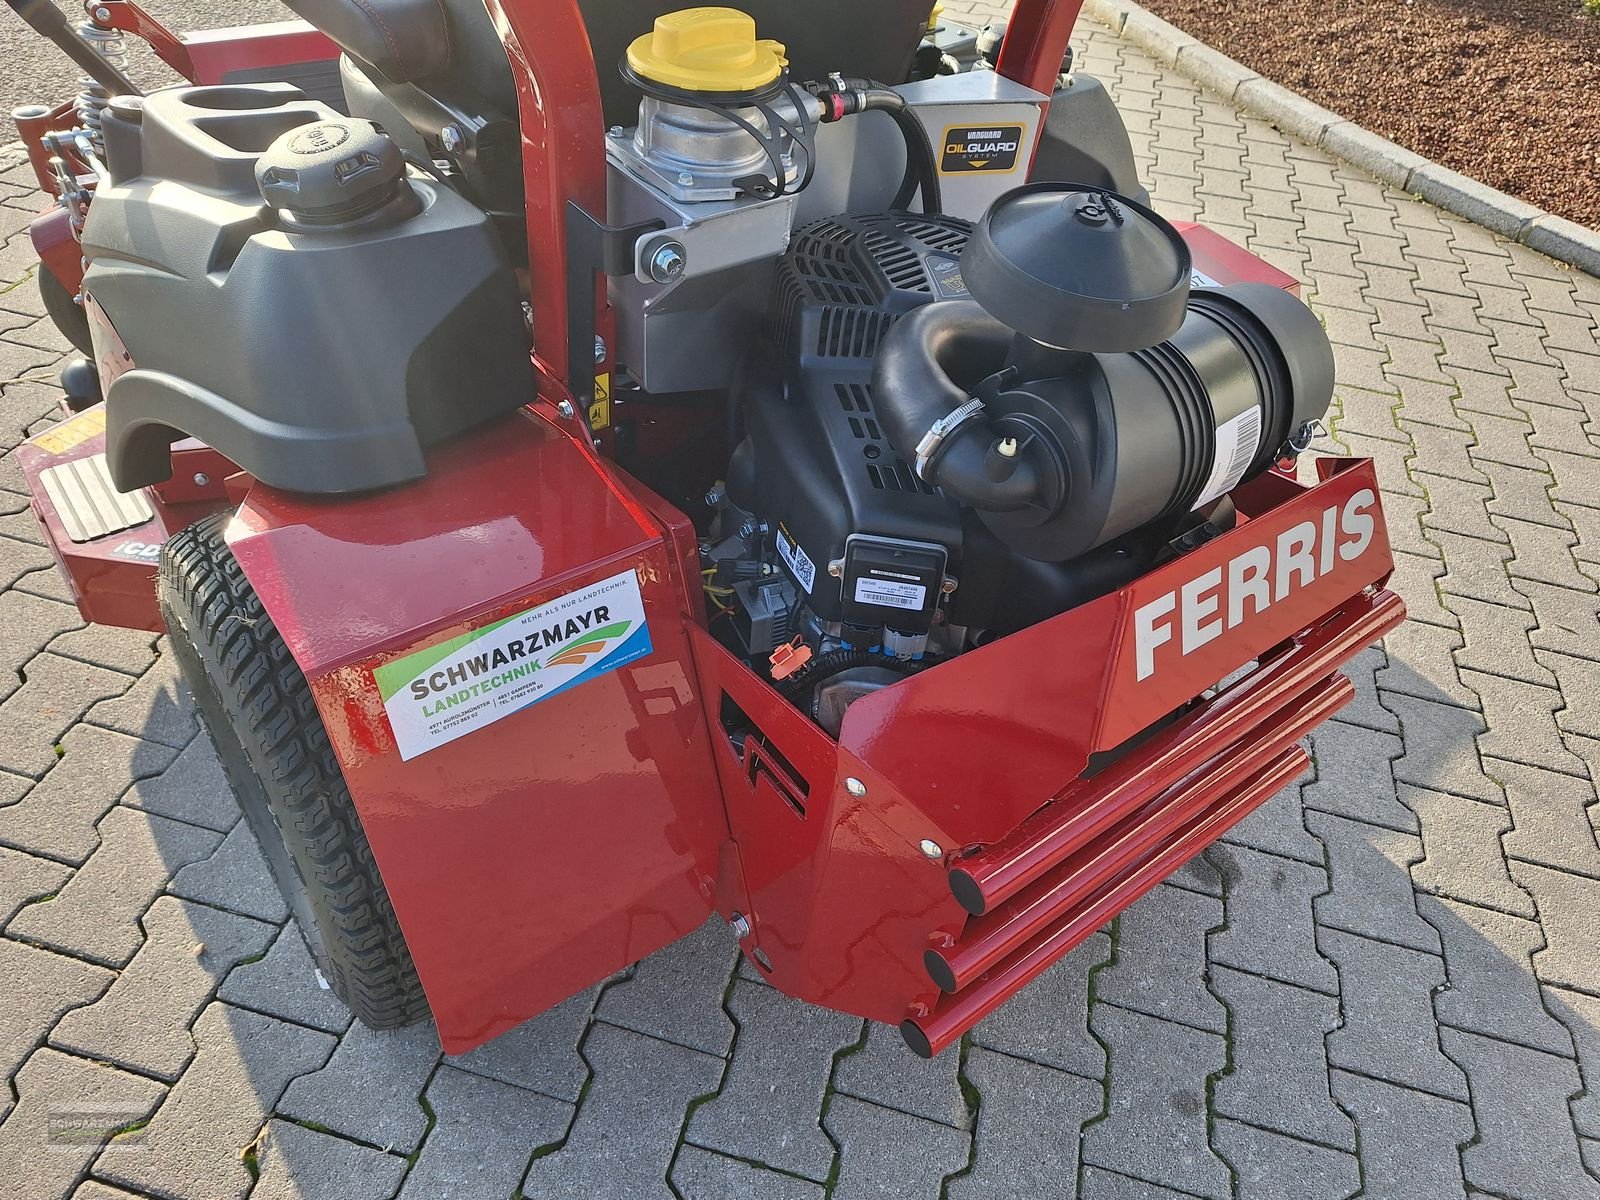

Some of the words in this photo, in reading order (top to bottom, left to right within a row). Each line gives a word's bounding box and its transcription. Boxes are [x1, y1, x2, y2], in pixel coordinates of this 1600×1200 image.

[945, 142, 1017, 154] OILGUARD
[967, 131, 1002, 140] VANGUARD
[1134, 488, 1376, 683] FERRIS
[521, 612, 543, 625] MEHR
[545, 606, 560, 616] ALS
[561, 599, 577, 610] NUR
[578, 579, 629, 603] LANDTECHNIK.
[410, 604, 611, 701] SCHWARZMAYR
[422, 657, 542, 718] LANDTECHNIK
[497, 692, 511, 701] 4851
[511, 681, 537, 695] GAMPERN
[428, 722, 443, 730] 4971
[443, 700, 491, 724] AUROLZMÜNSTER
[430, 728, 442, 736] TEL.
[443, 719, 460, 731] 07752
